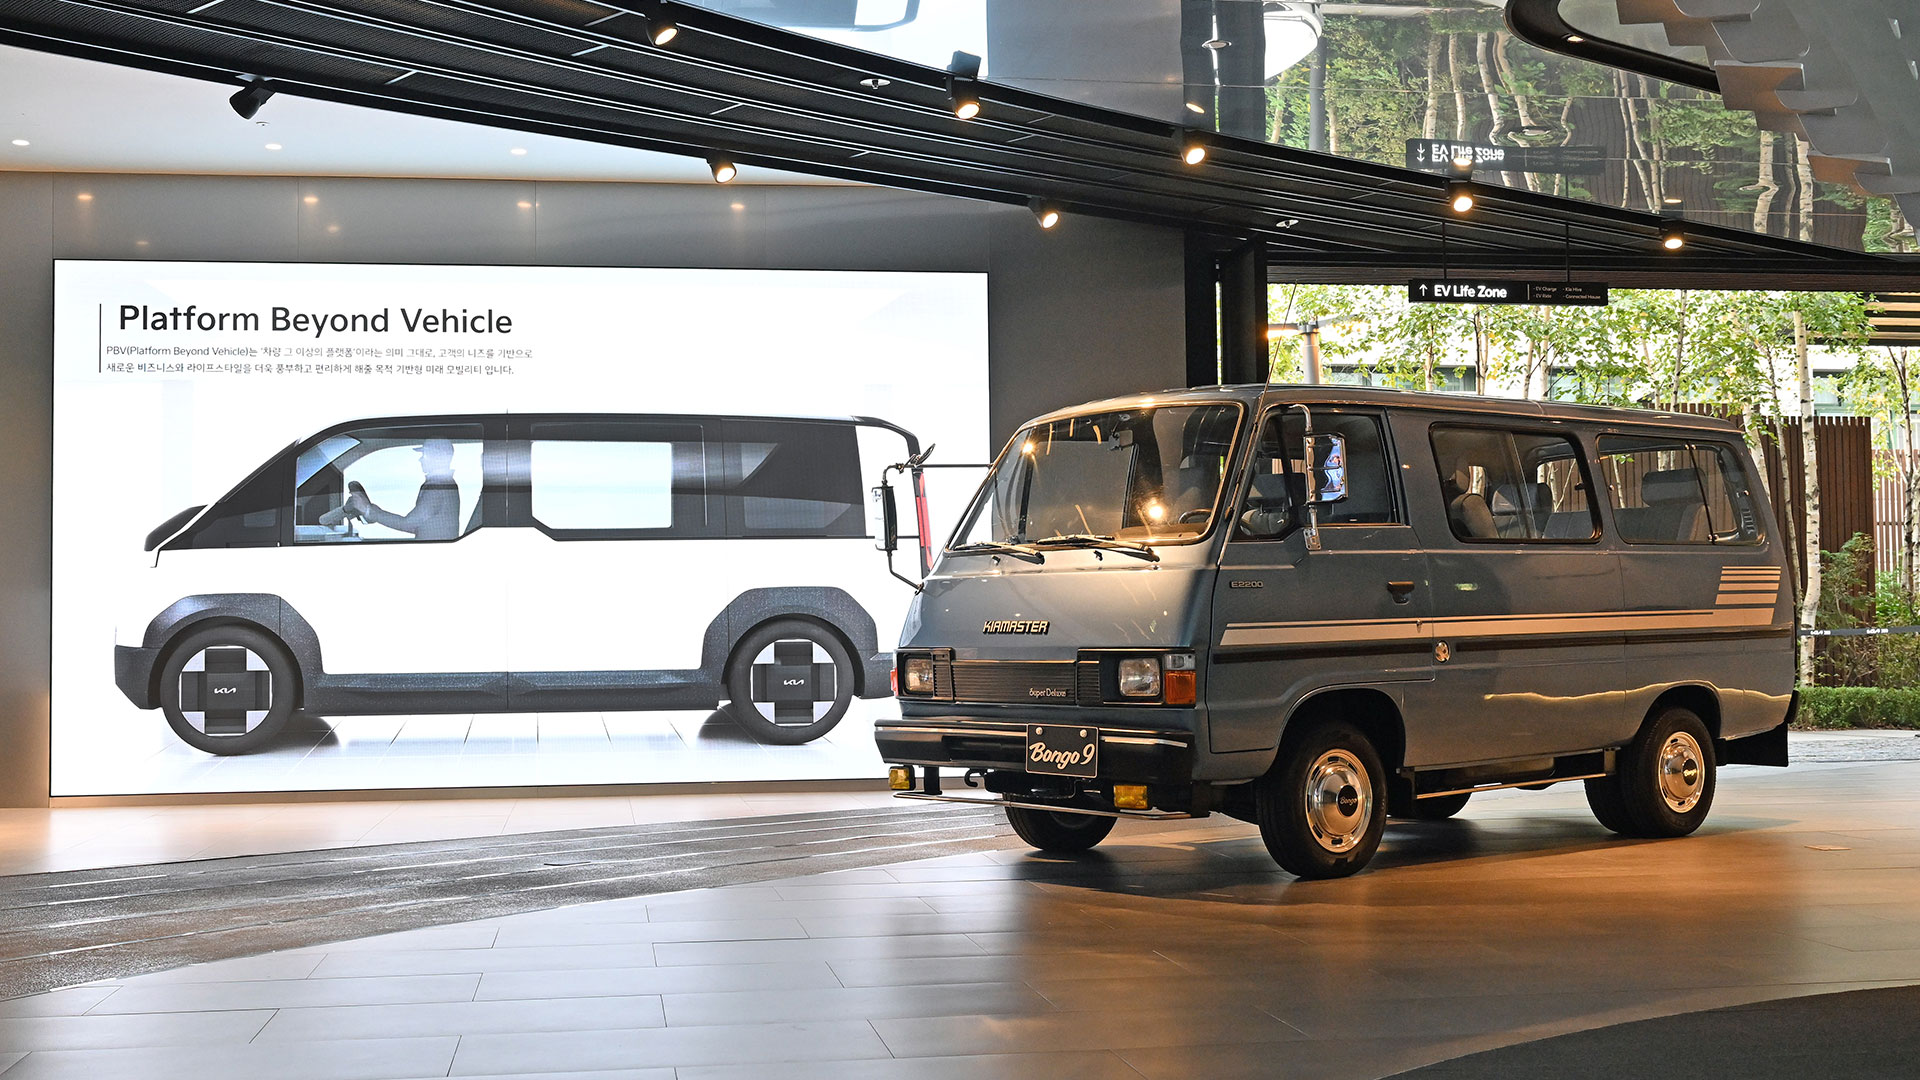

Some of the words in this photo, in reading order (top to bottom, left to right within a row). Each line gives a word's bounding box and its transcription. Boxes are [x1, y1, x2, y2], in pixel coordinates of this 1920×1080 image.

[1433, 284, 1451, 297] EV
[1453, 284, 1476, 297] Life
[1477, 285, 1508, 298] Zone
[120, 305, 259, 330] Platform
[271, 306, 389, 338] Beyond
[400, 307, 513, 334] Vehicle
[106, 345, 171, 356] PBV(Platform
[173, 346, 210, 357] Beyond
[211, 346, 258, 357] Vehicle)는
[283, 347, 293, 357] 그
[295, 347, 323, 358] 이상의
[385, 347, 404, 358] 의미
[438, 348, 465, 359] 고객의
[467, 348, 495, 359] 니즈를
[497, 348, 533, 360] 기반으로
[106, 362, 135, 374] 새로운
[137, 362, 184, 373] 비즈니스와
[186, 362, 253, 375] 라이프스타일을
[254, 363, 274, 374] 더욱
[275, 363, 313, 375] 풍부하고
[315, 363, 352, 375] 편리하게
[375, 364, 393, 375] 목적
[396, 364, 423, 375] 기반형
[425, 364, 444, 375] 미래
[446, 364, 482, 376] 모빌리티
[484, 365, 515, 376] 입니다.
[1231, 580, 1264, 588] E2200
[982, 620, 1050, 635] KIAMASTER
[1029, 687, 1046, 698] Super
[1046, 688, 1067, 697] Deluxe
[1029, 742, 1080, 770] Bongo
[1080, 743, 1096, 765] 9
[1340, 797, 1357, 806] Bongo
